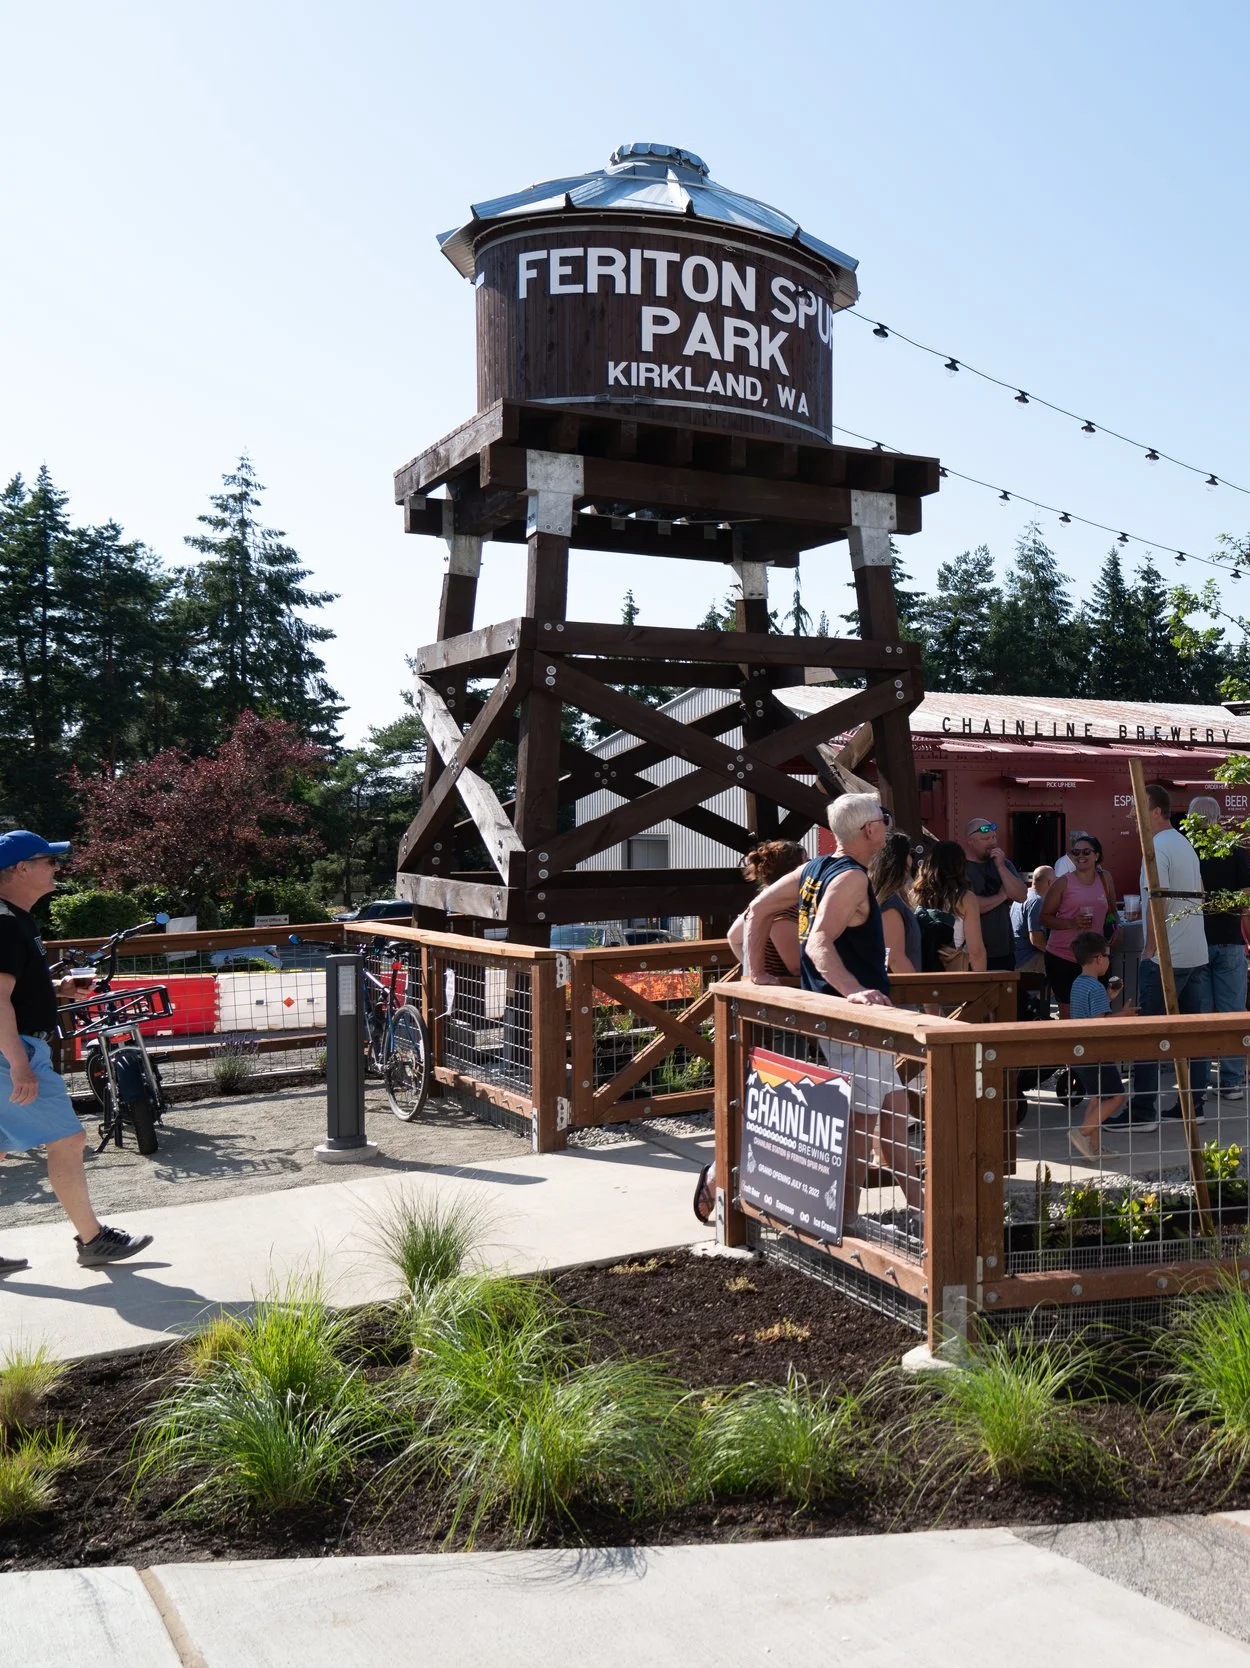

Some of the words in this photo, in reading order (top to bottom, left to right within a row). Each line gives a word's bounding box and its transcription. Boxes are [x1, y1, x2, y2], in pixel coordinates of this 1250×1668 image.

[519, 246, 755, 312] FERITON
[641, 305, 790, 377] PARK
[608, 361, 769, 408] KIRKLAND,
[777, 383, 809, 417] WA
[942, 717, 1093, 738] CHAINLINE
[1119, 725, 1230, 743] BREWERY
[1225, 795, 1248, 807] BEER
[747, 1087, 844, 1154] CHAINLINE
[753, 1137, 772, 1151] CHAINLINE
[772, 1144, 786, 1158] STATION
[790, 1152, 807, 1166] FERITON
[807, 1159, 818, 1170] SPUR
[818, 1163, 830, 1175] PARK
[798, 1142, 830, 1163] BREWING
[832, 1155, 842, 1167] CO
[758, 1163, 772, 1176] GRAND
[772, 1170, 791, 1186] OPENING
[790, 1179, 802, 1190] JULY
[808, 1186, 820, 1198] 2022
[775, 1199, 795, 1216] Espresso
[820, 1220, 837, 1235] Cream
